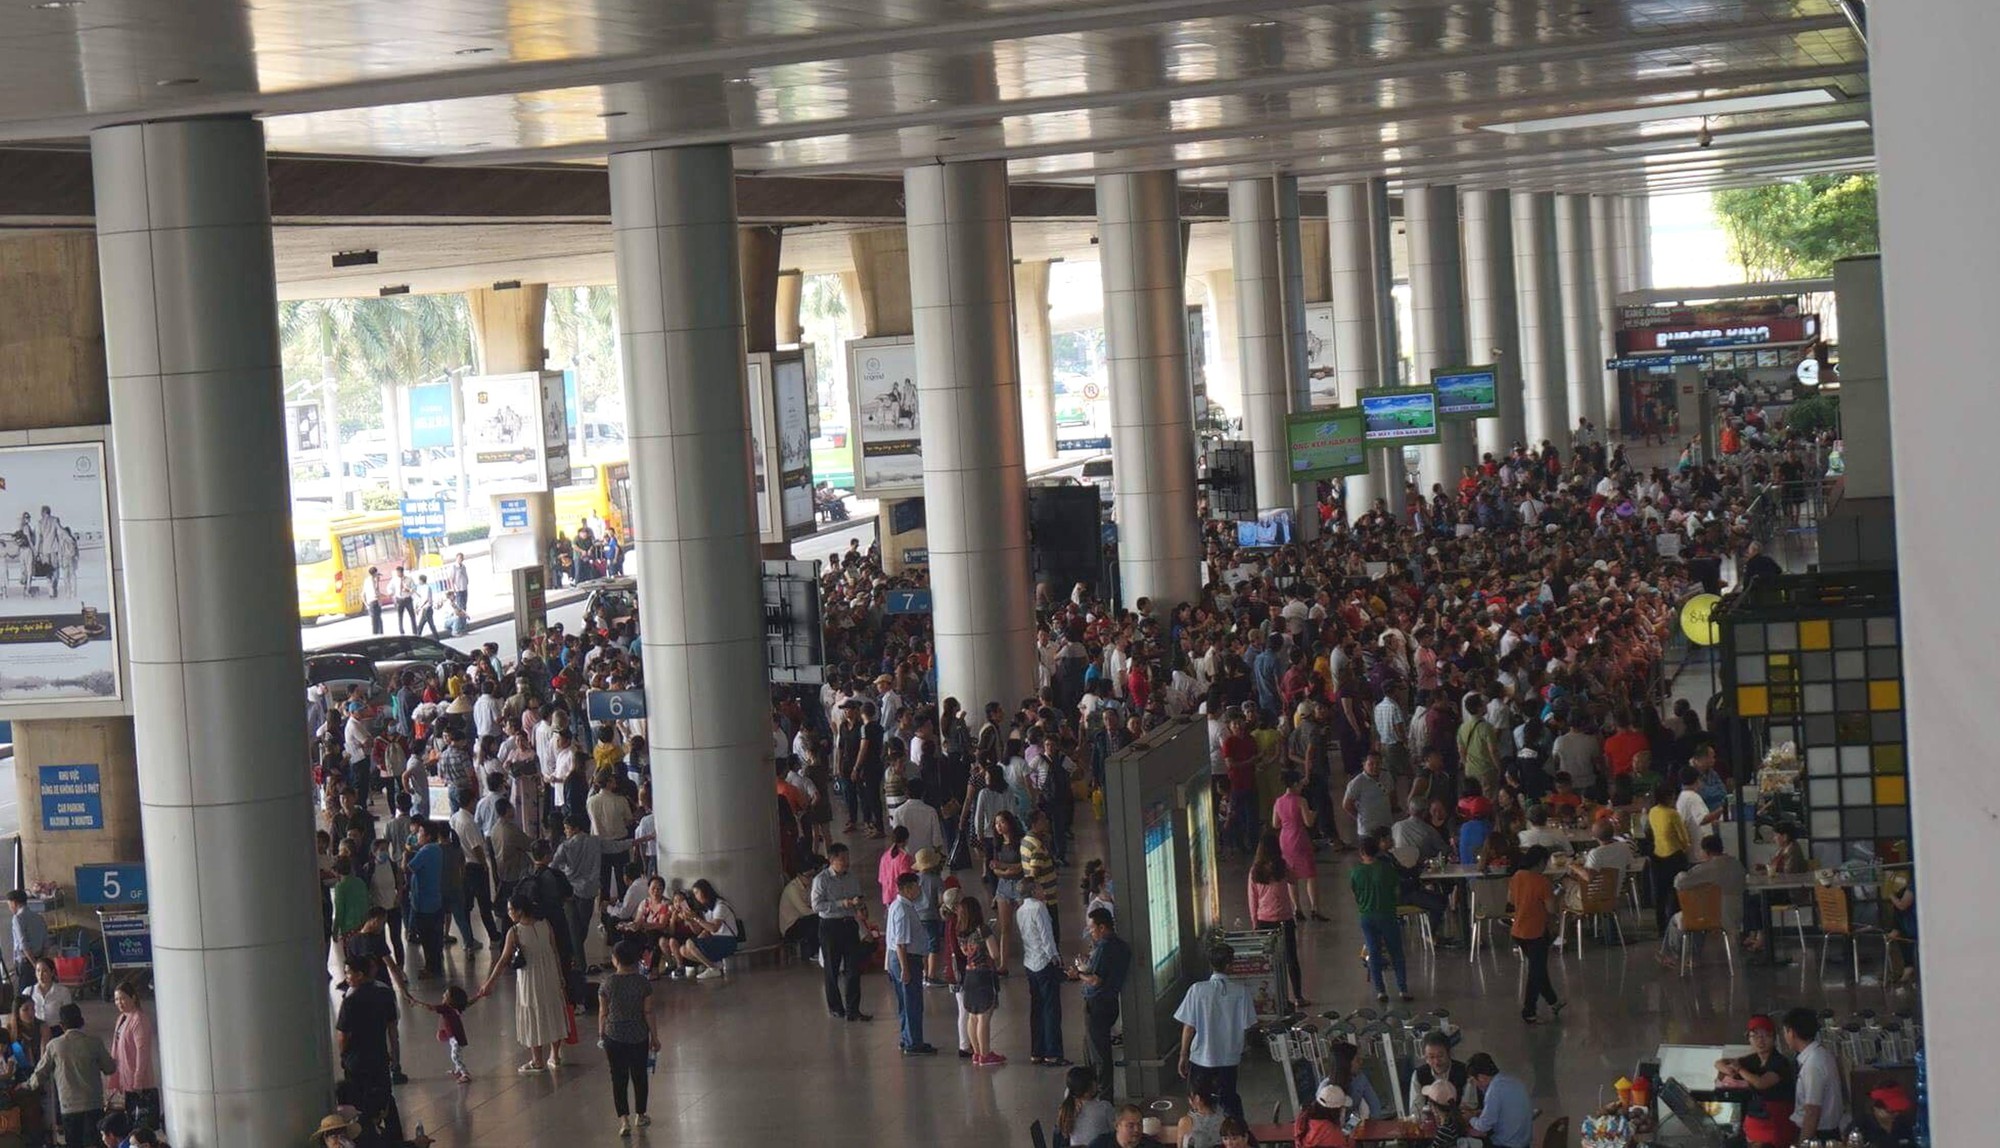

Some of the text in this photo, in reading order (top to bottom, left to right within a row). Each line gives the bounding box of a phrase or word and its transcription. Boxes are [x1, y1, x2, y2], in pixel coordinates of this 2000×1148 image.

[902, 593, 914, 610] 7
[610, 695, 623, 716] 6
[103, 871, 143, 899] 5 GF
